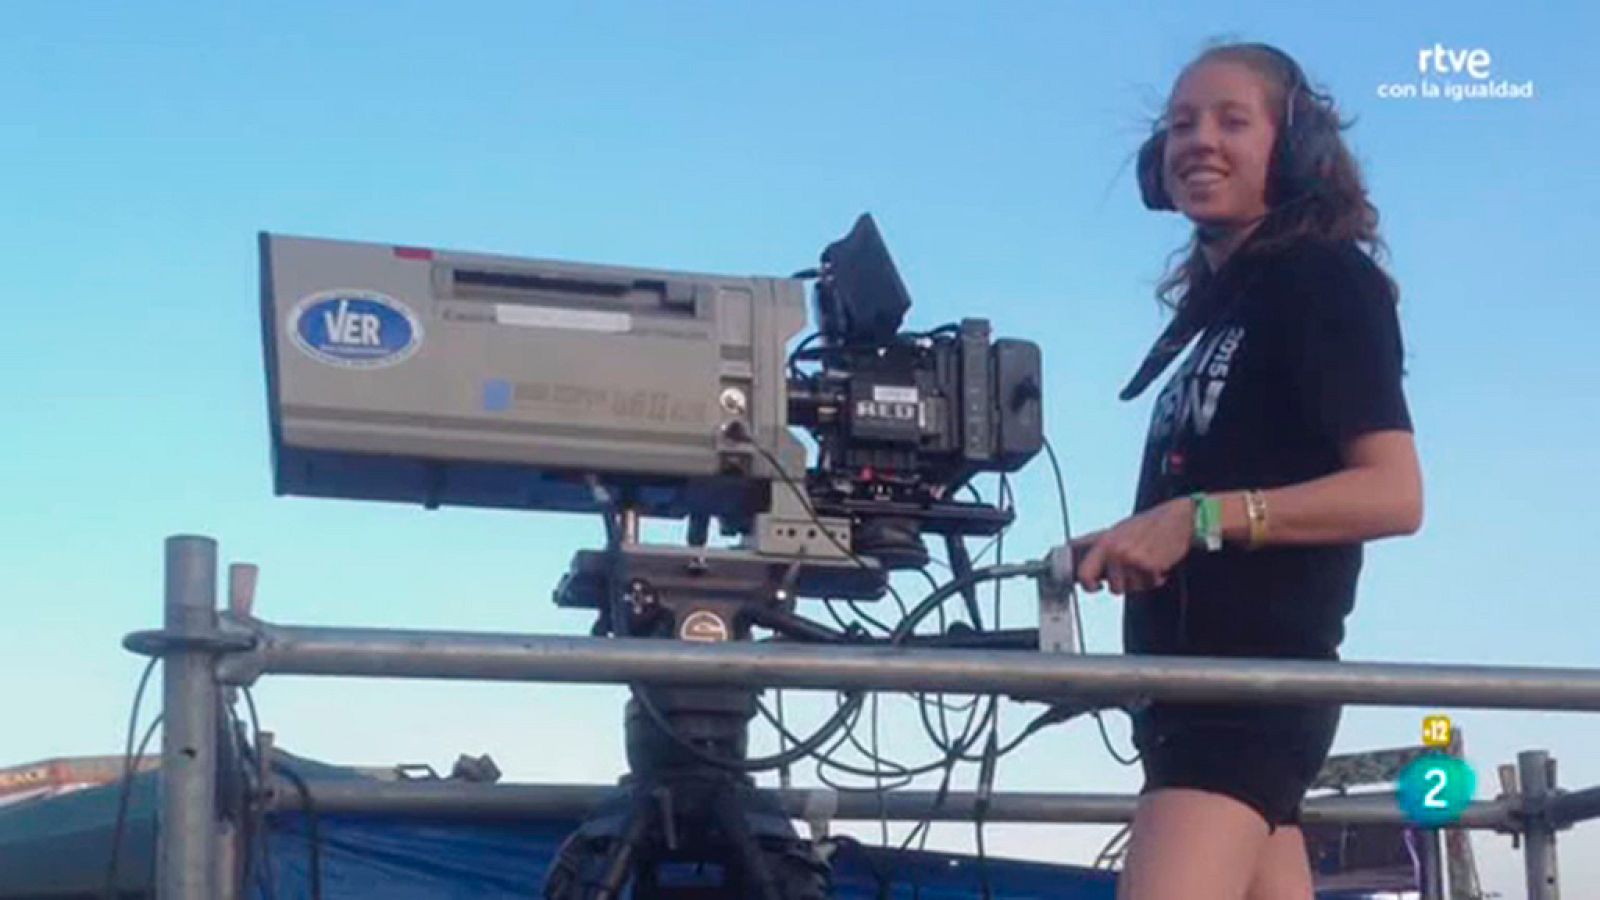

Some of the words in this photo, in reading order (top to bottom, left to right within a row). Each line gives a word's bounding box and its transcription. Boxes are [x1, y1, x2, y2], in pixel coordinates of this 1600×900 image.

[324, 299, 381, 345] VER
[1208, 327, 1245, 378] 2015
[857, 401, 915, 419] RED
